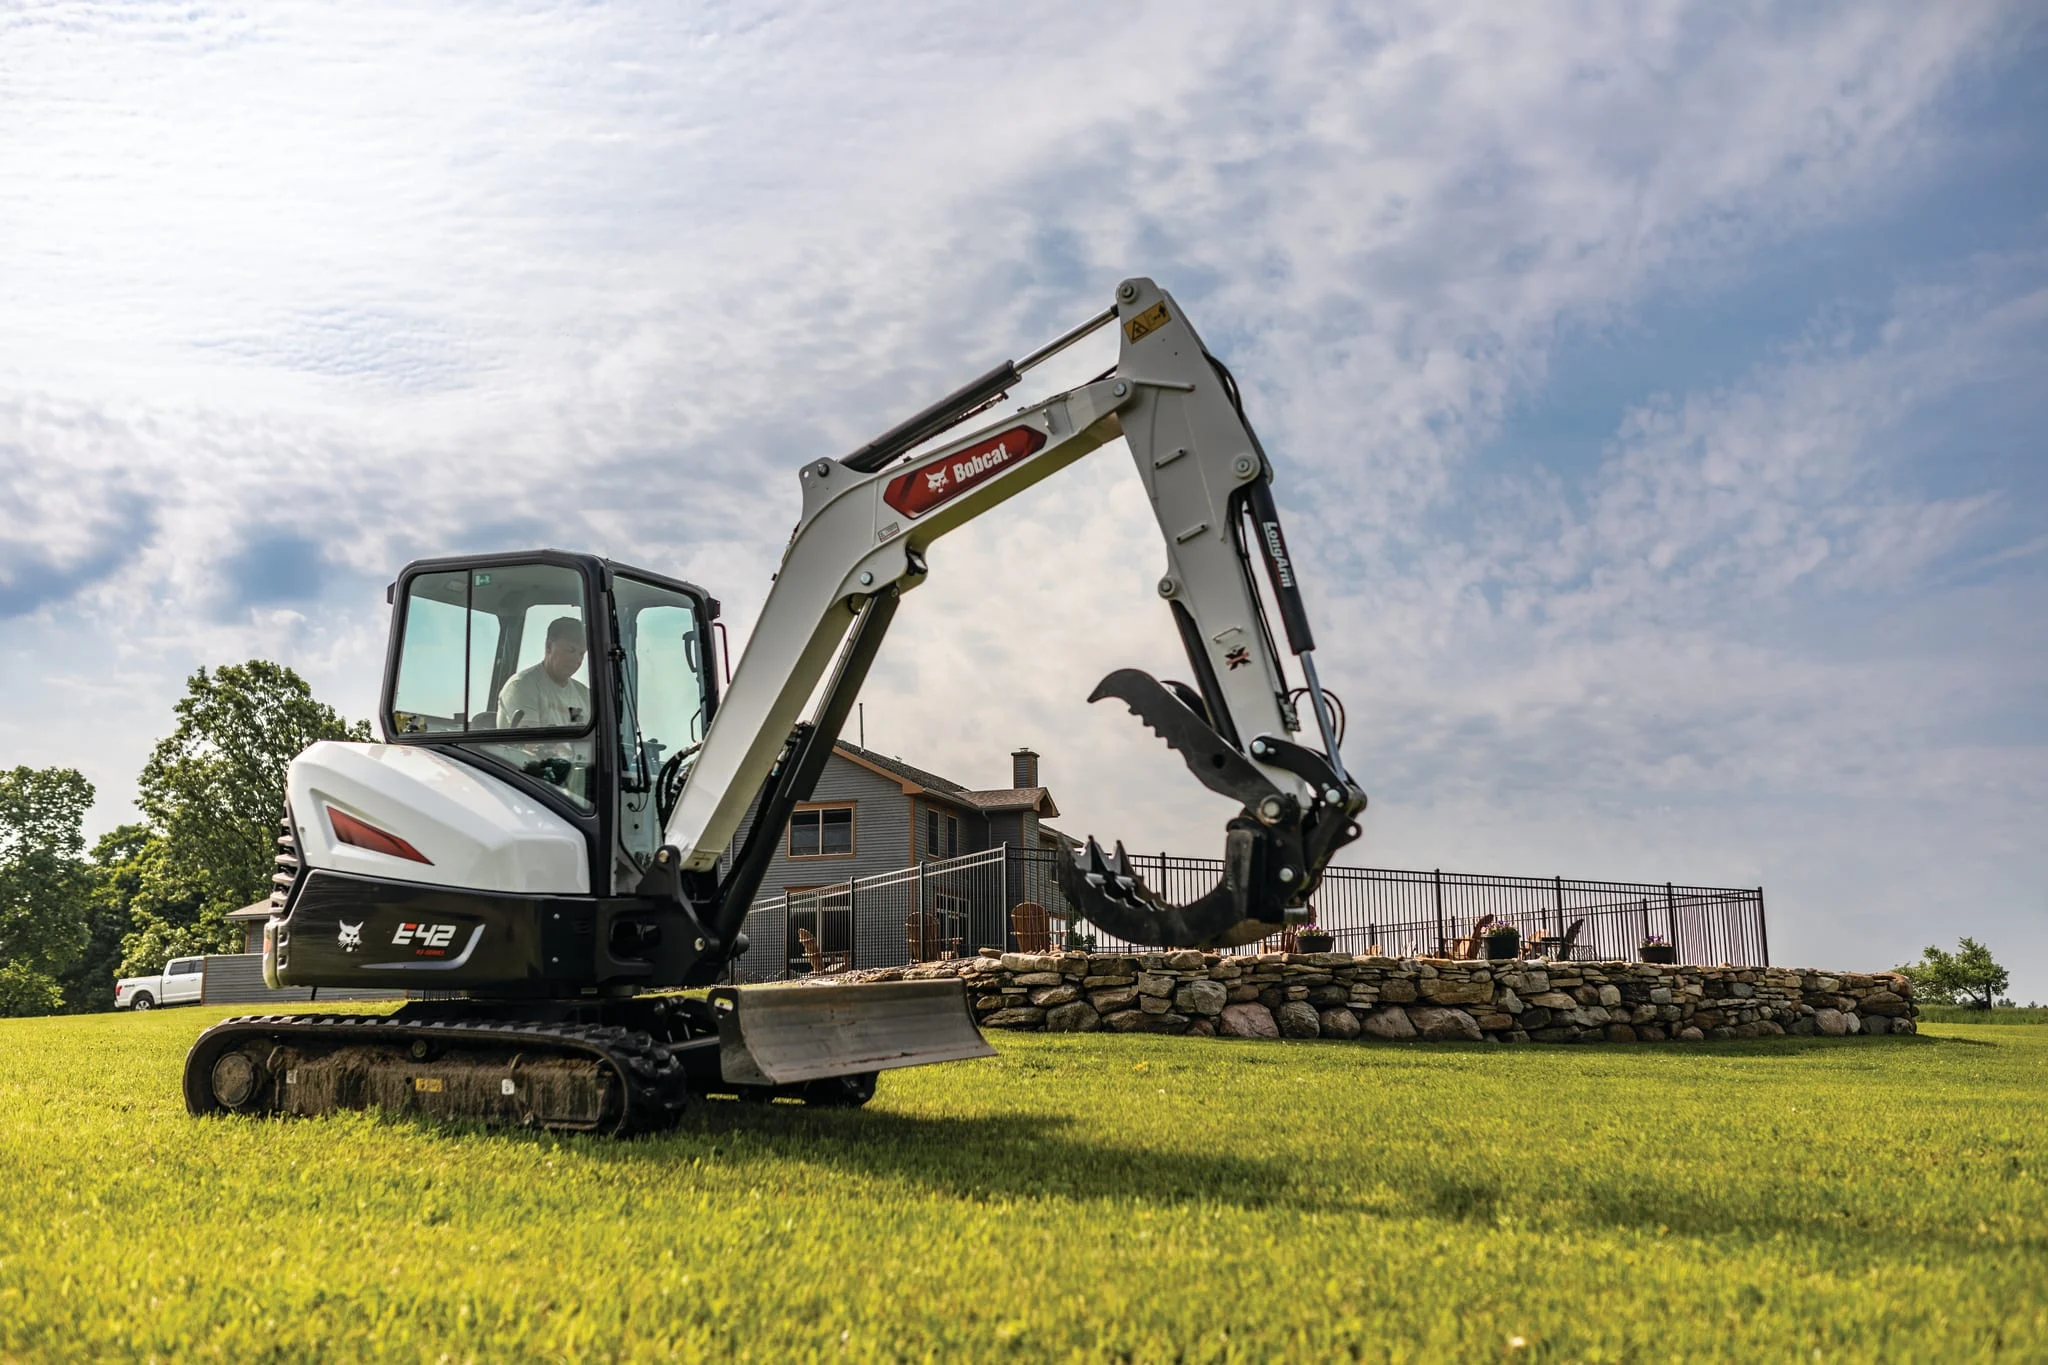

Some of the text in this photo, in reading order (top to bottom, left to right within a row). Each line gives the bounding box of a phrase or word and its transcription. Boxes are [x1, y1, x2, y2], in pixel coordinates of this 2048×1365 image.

[952, 442, 1009, 484] Bobcat
[1262, 521, 1292, 588] LongArm
[391, 922, 457, 947] E42
